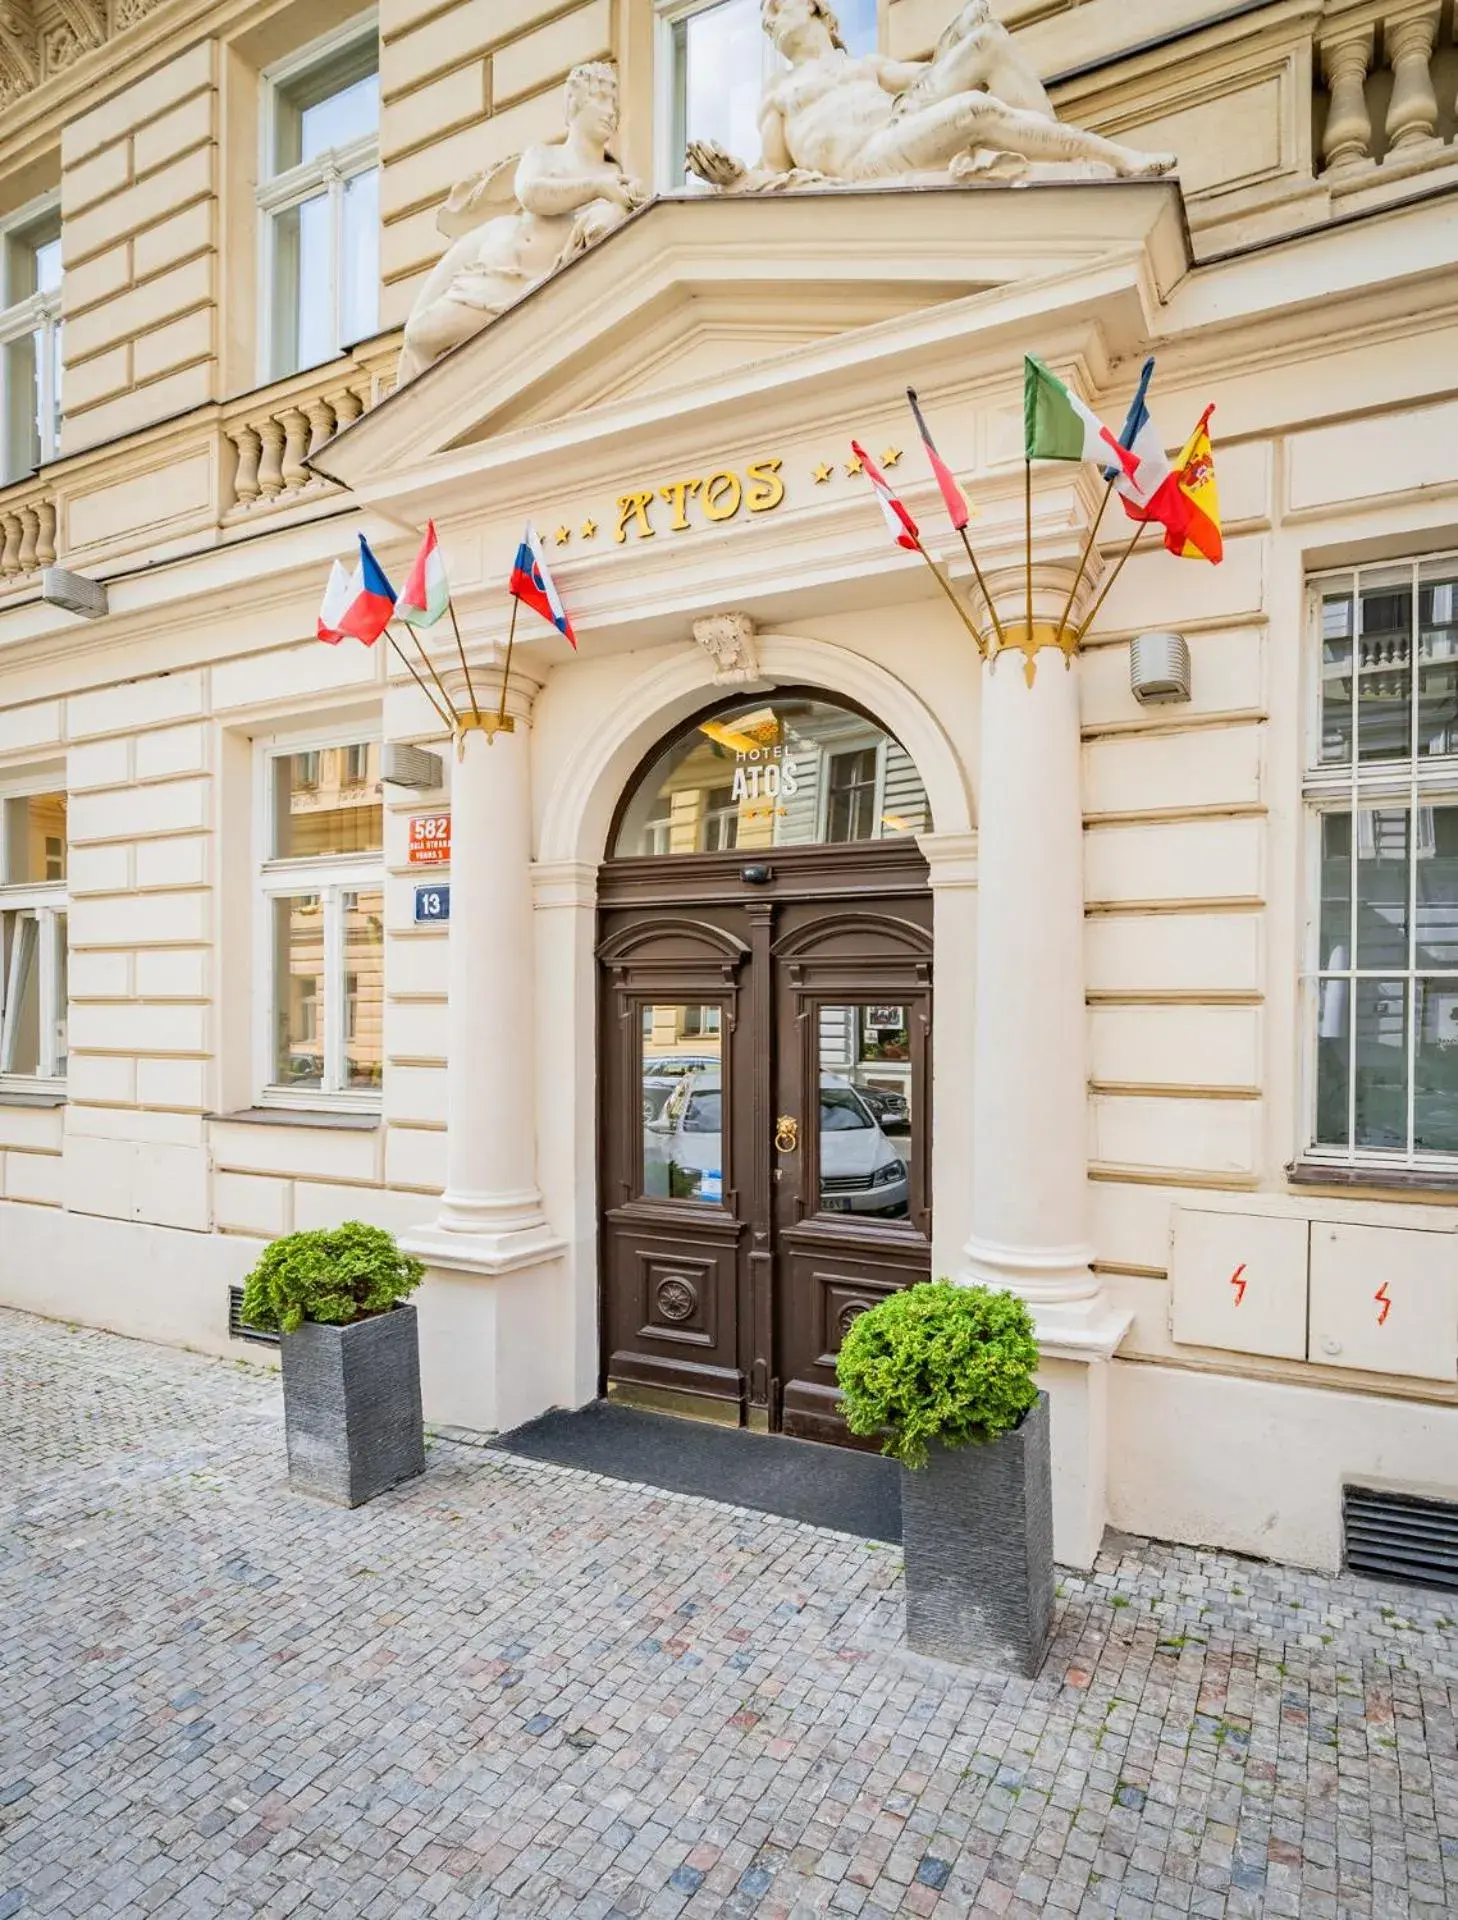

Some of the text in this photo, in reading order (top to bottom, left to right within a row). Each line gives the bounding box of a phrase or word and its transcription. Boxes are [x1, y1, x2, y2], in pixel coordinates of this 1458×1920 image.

[615, 457, 784, 543] ATOS
[736, 745, 792, 762] HOTEL
[731, 761, 798, 800] ATOS
[415, 819, 447, 839] 582
[422, 893, 440, 914] 13
